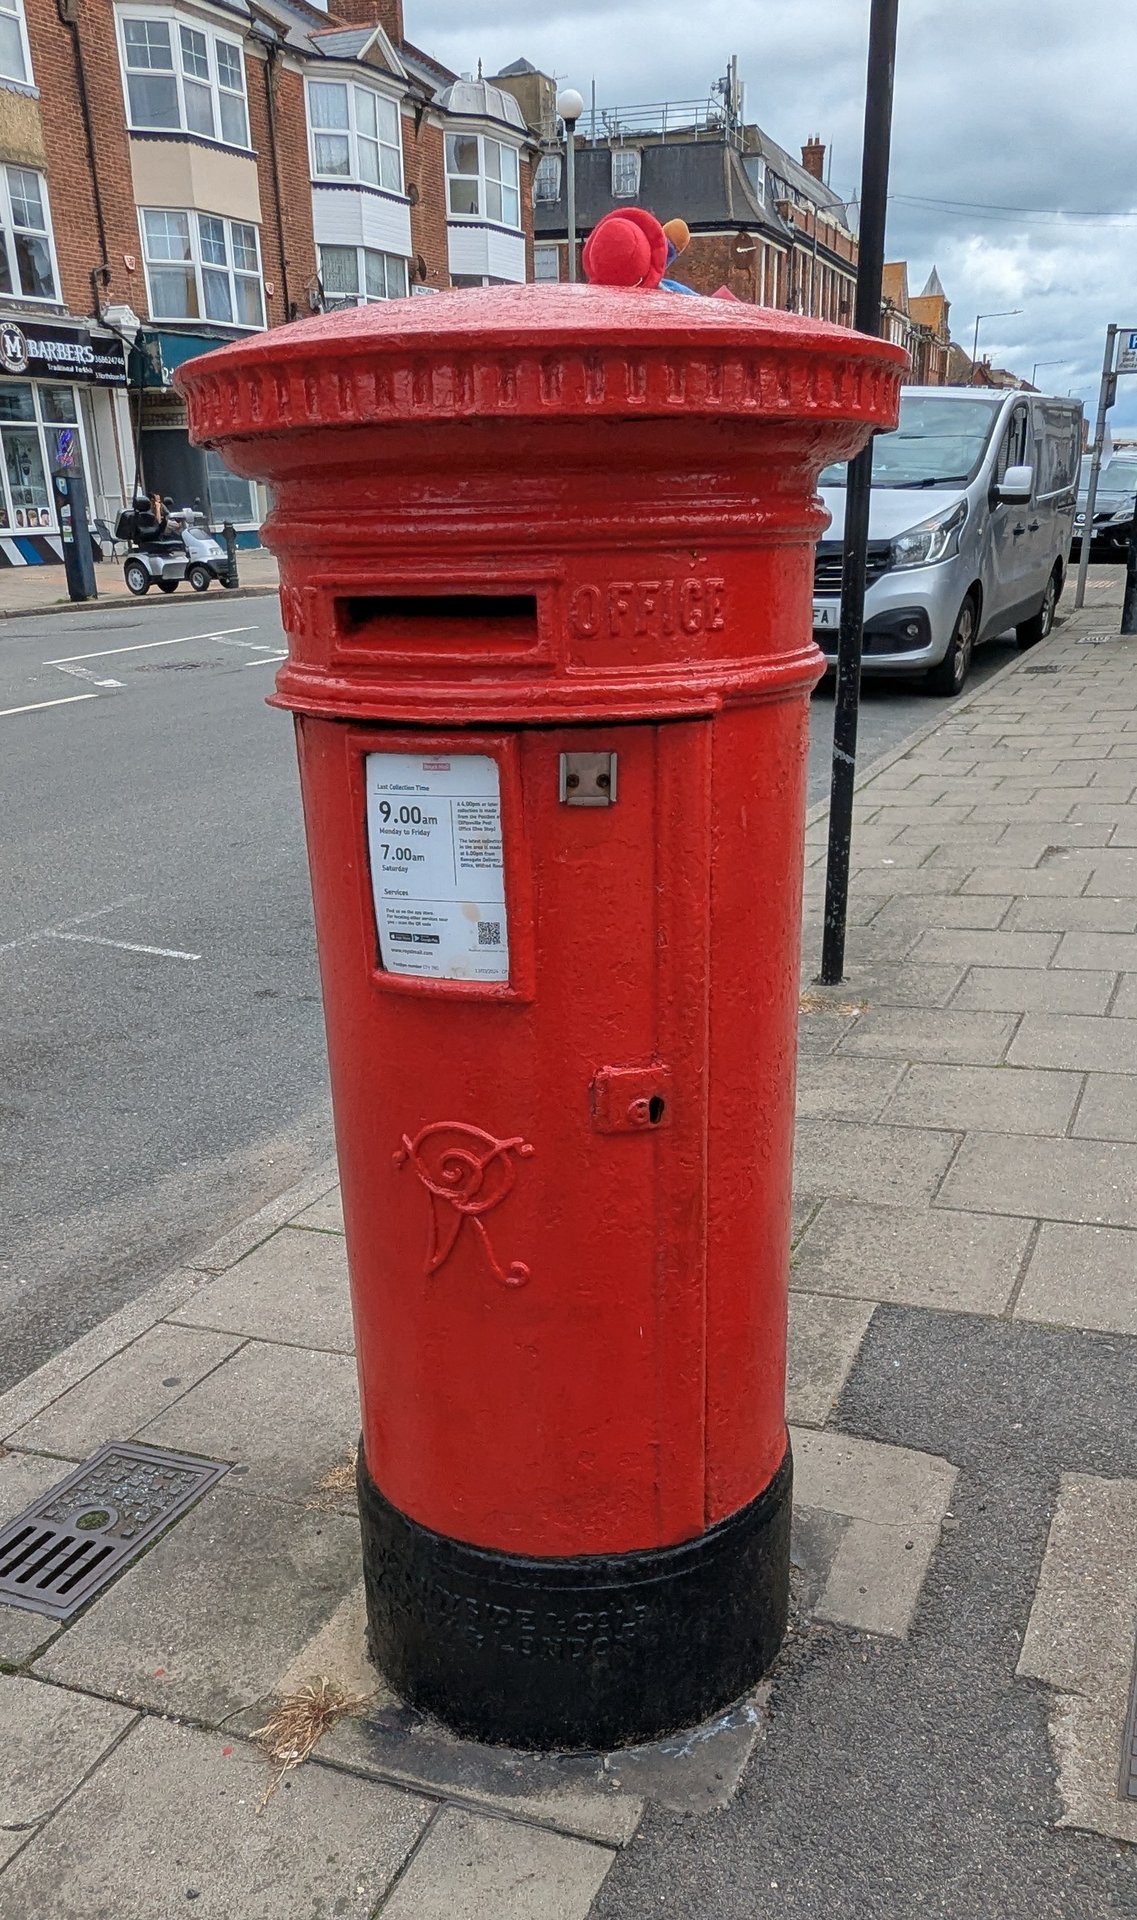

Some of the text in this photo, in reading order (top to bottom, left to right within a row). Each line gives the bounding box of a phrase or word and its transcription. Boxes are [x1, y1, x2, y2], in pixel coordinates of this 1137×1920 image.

[4, 334, 24, 358] M
[27, 339, 94, 364] BARBERS
[568, 577, 726, 637] OFFICE
[379, 800, 438, 825] 9.00am
[379, 828, 402, 836] Monday
[411, 829, 430, 837] Friday
[380, 844, 425, 862] 7.00am
[382, 864, 409, 873] Saturday
[384, 888, 408, 896] Services
